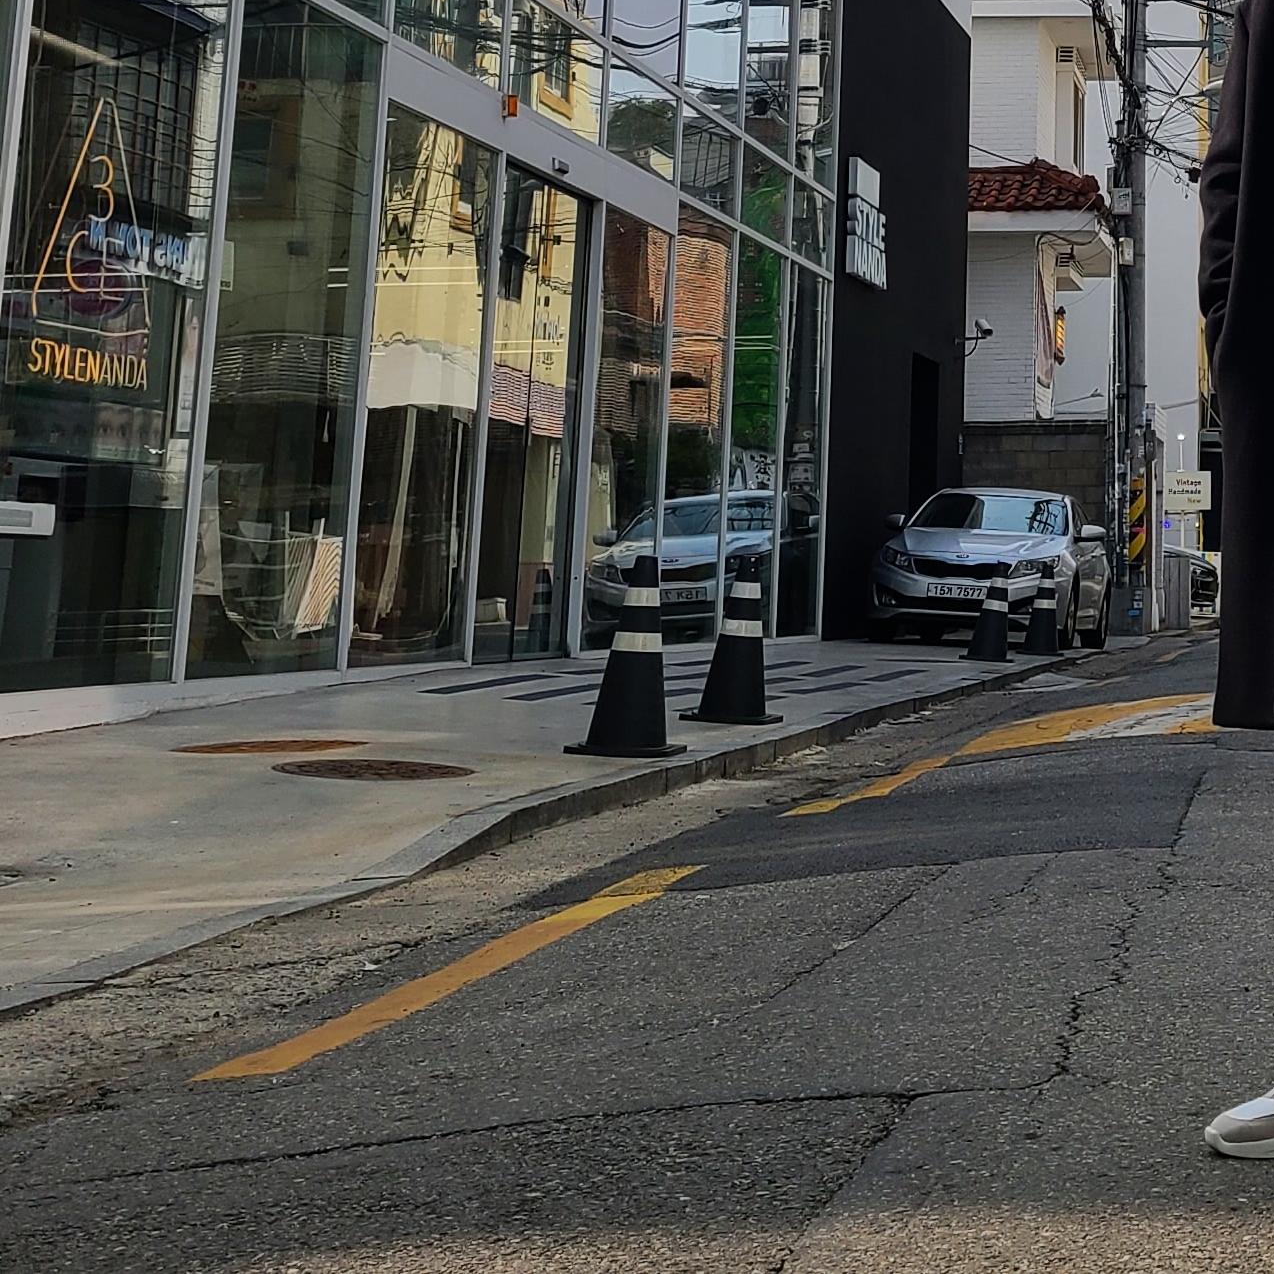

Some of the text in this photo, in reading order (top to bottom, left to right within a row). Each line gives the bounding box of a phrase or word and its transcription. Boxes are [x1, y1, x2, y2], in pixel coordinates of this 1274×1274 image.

[852, 197, 887, 252] STYLE
[851, 235, 888, 290] NANDA
[28, 337, 148, 391] STYLENANDA
[956, 586, 983, 598] 7577
